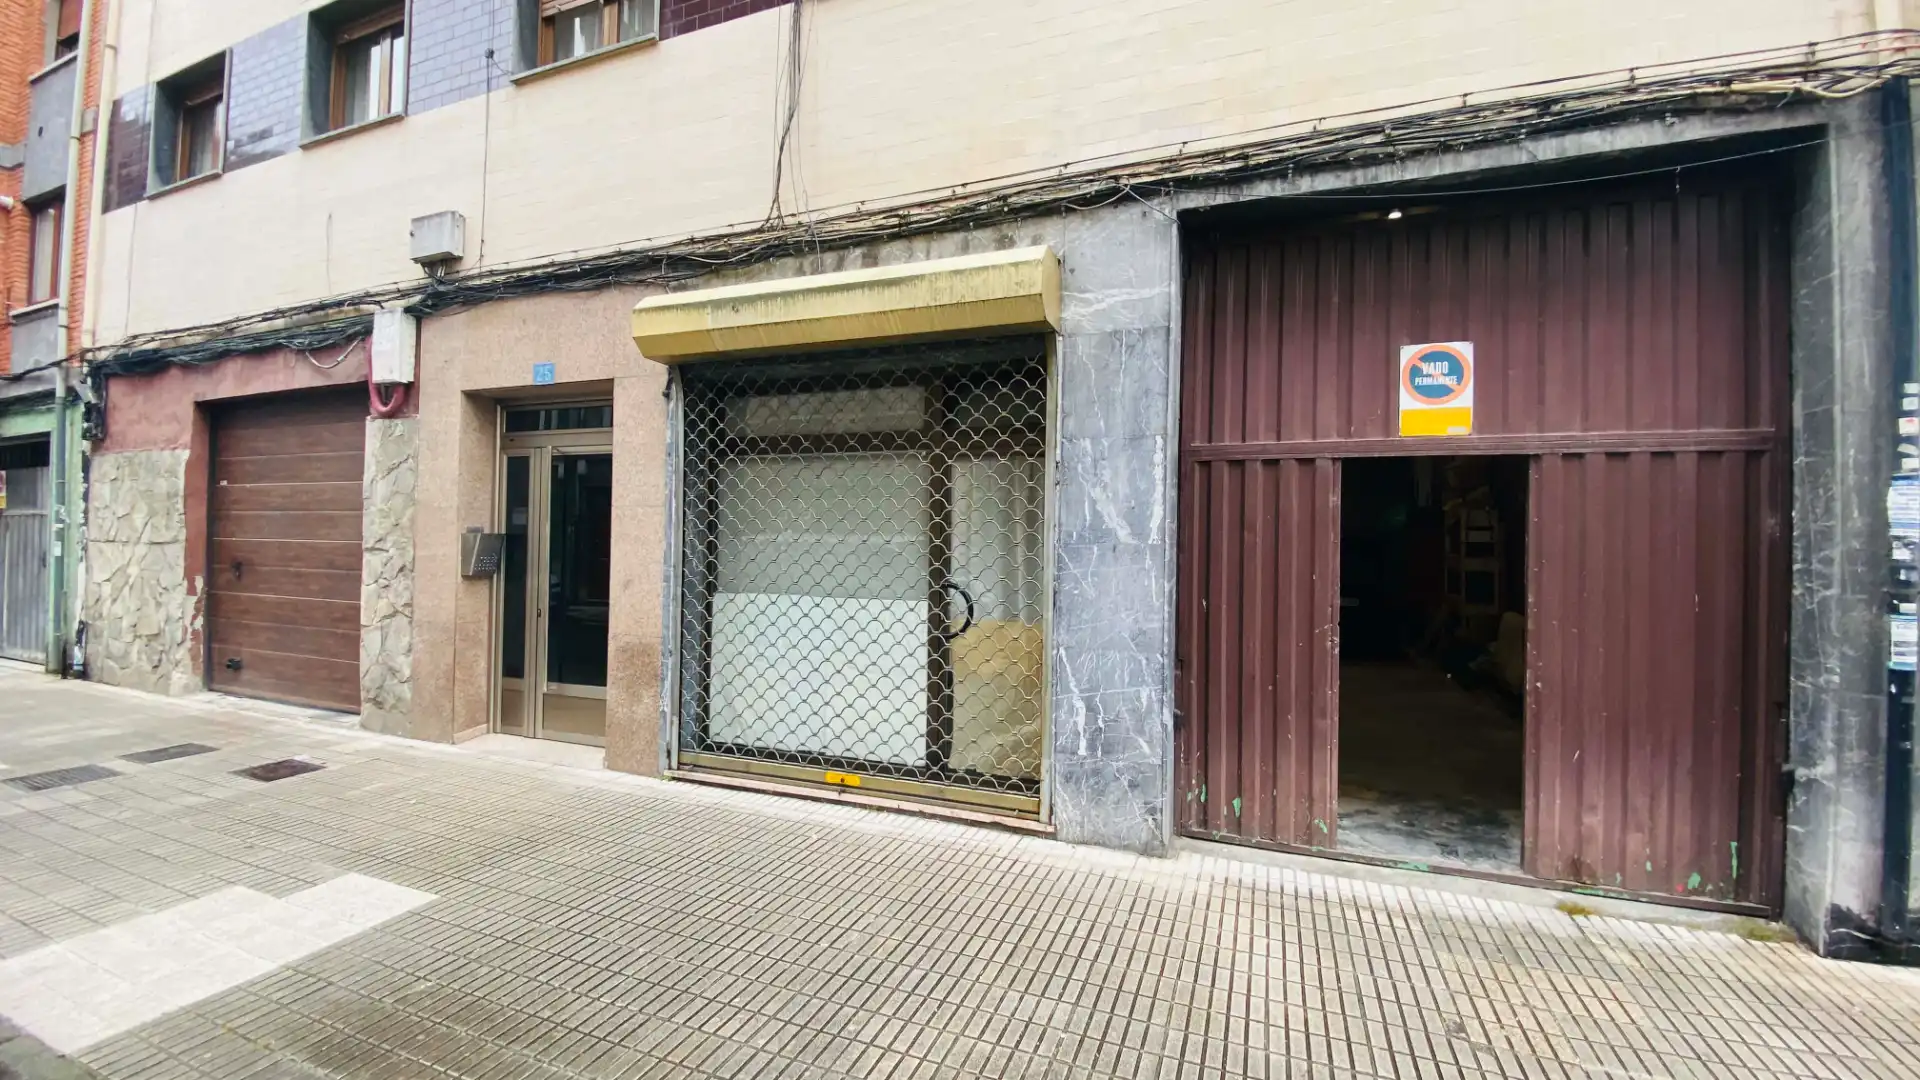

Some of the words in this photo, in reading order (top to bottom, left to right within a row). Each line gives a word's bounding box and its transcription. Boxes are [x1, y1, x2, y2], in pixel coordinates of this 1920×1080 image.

[536, 365, 552, 381] 25
[1422, 361, 1449, 375] VADO
[1414, 375, 1458, 386] PERMANENTE
